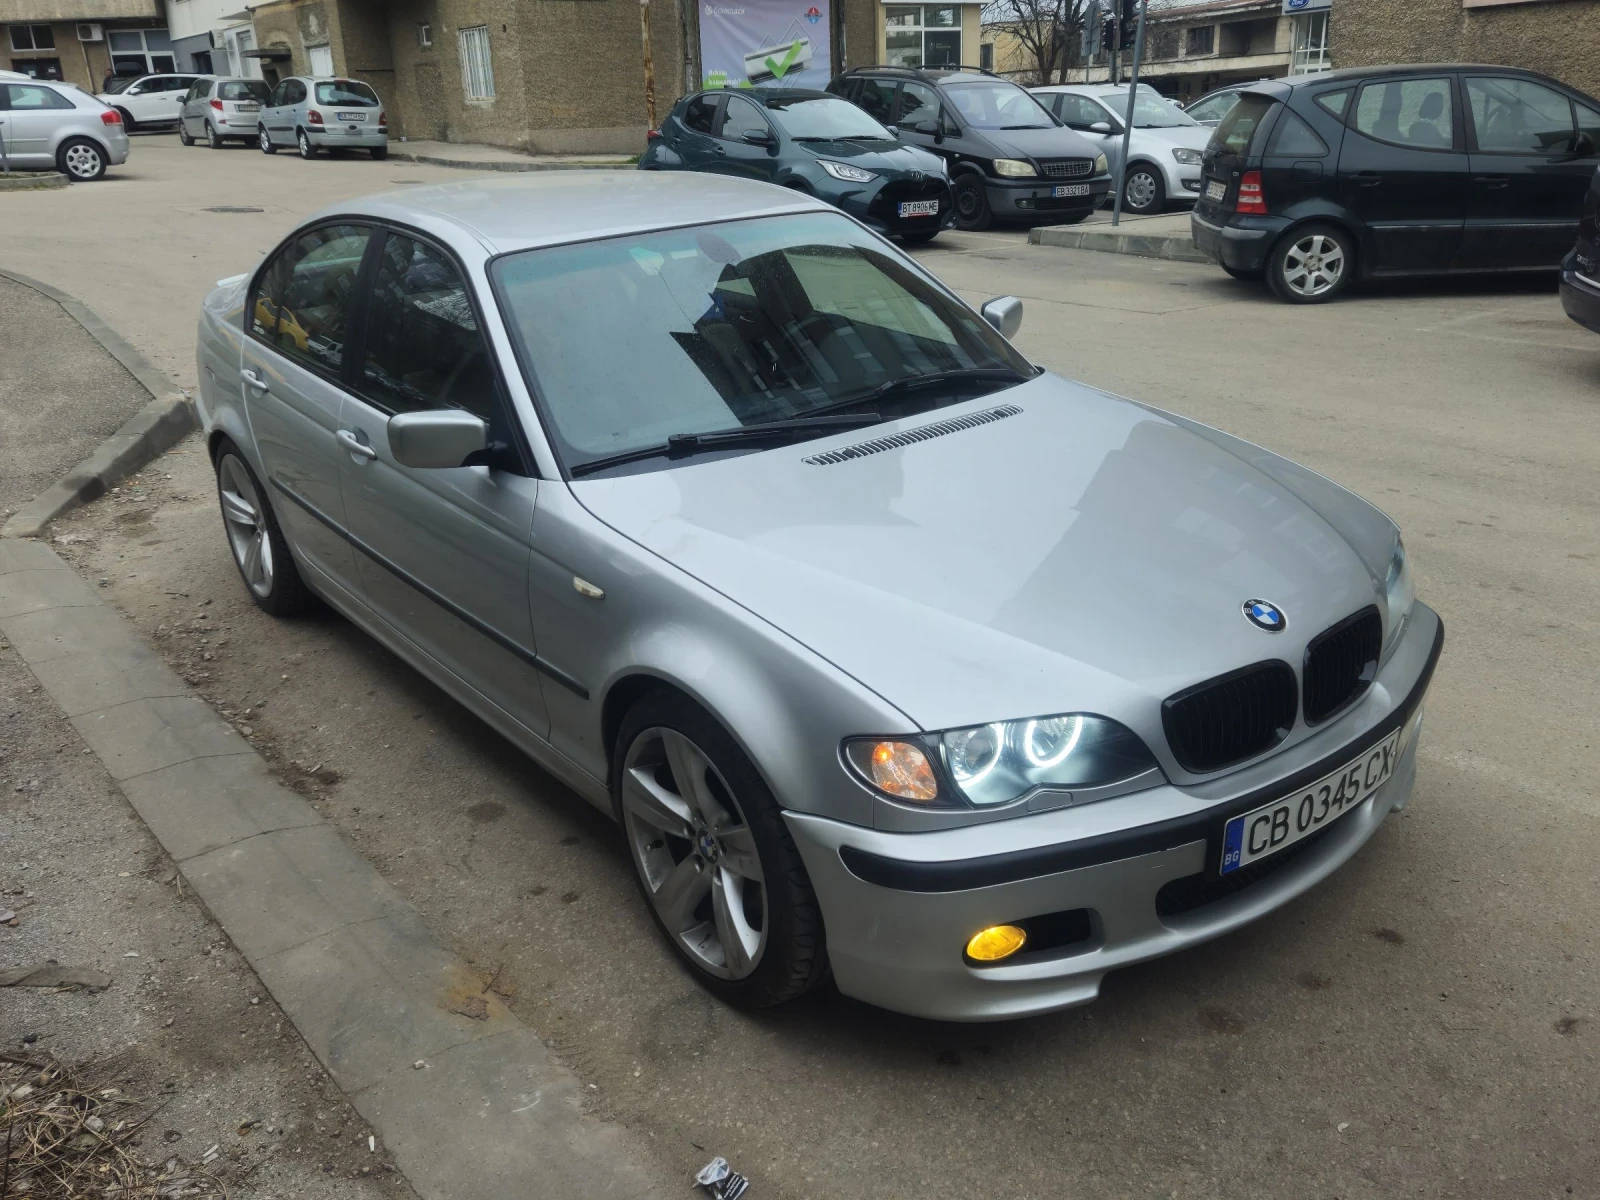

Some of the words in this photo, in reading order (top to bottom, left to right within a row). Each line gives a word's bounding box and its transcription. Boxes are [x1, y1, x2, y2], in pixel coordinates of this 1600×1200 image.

[902, 203, 912, 213] BT
[1249, 805, 1290, 855] CB
[1297, 764, 1362, 832] 0345
[1364, 738, 1396, 791] CX
[1224, 850, 1239, 866] BG
